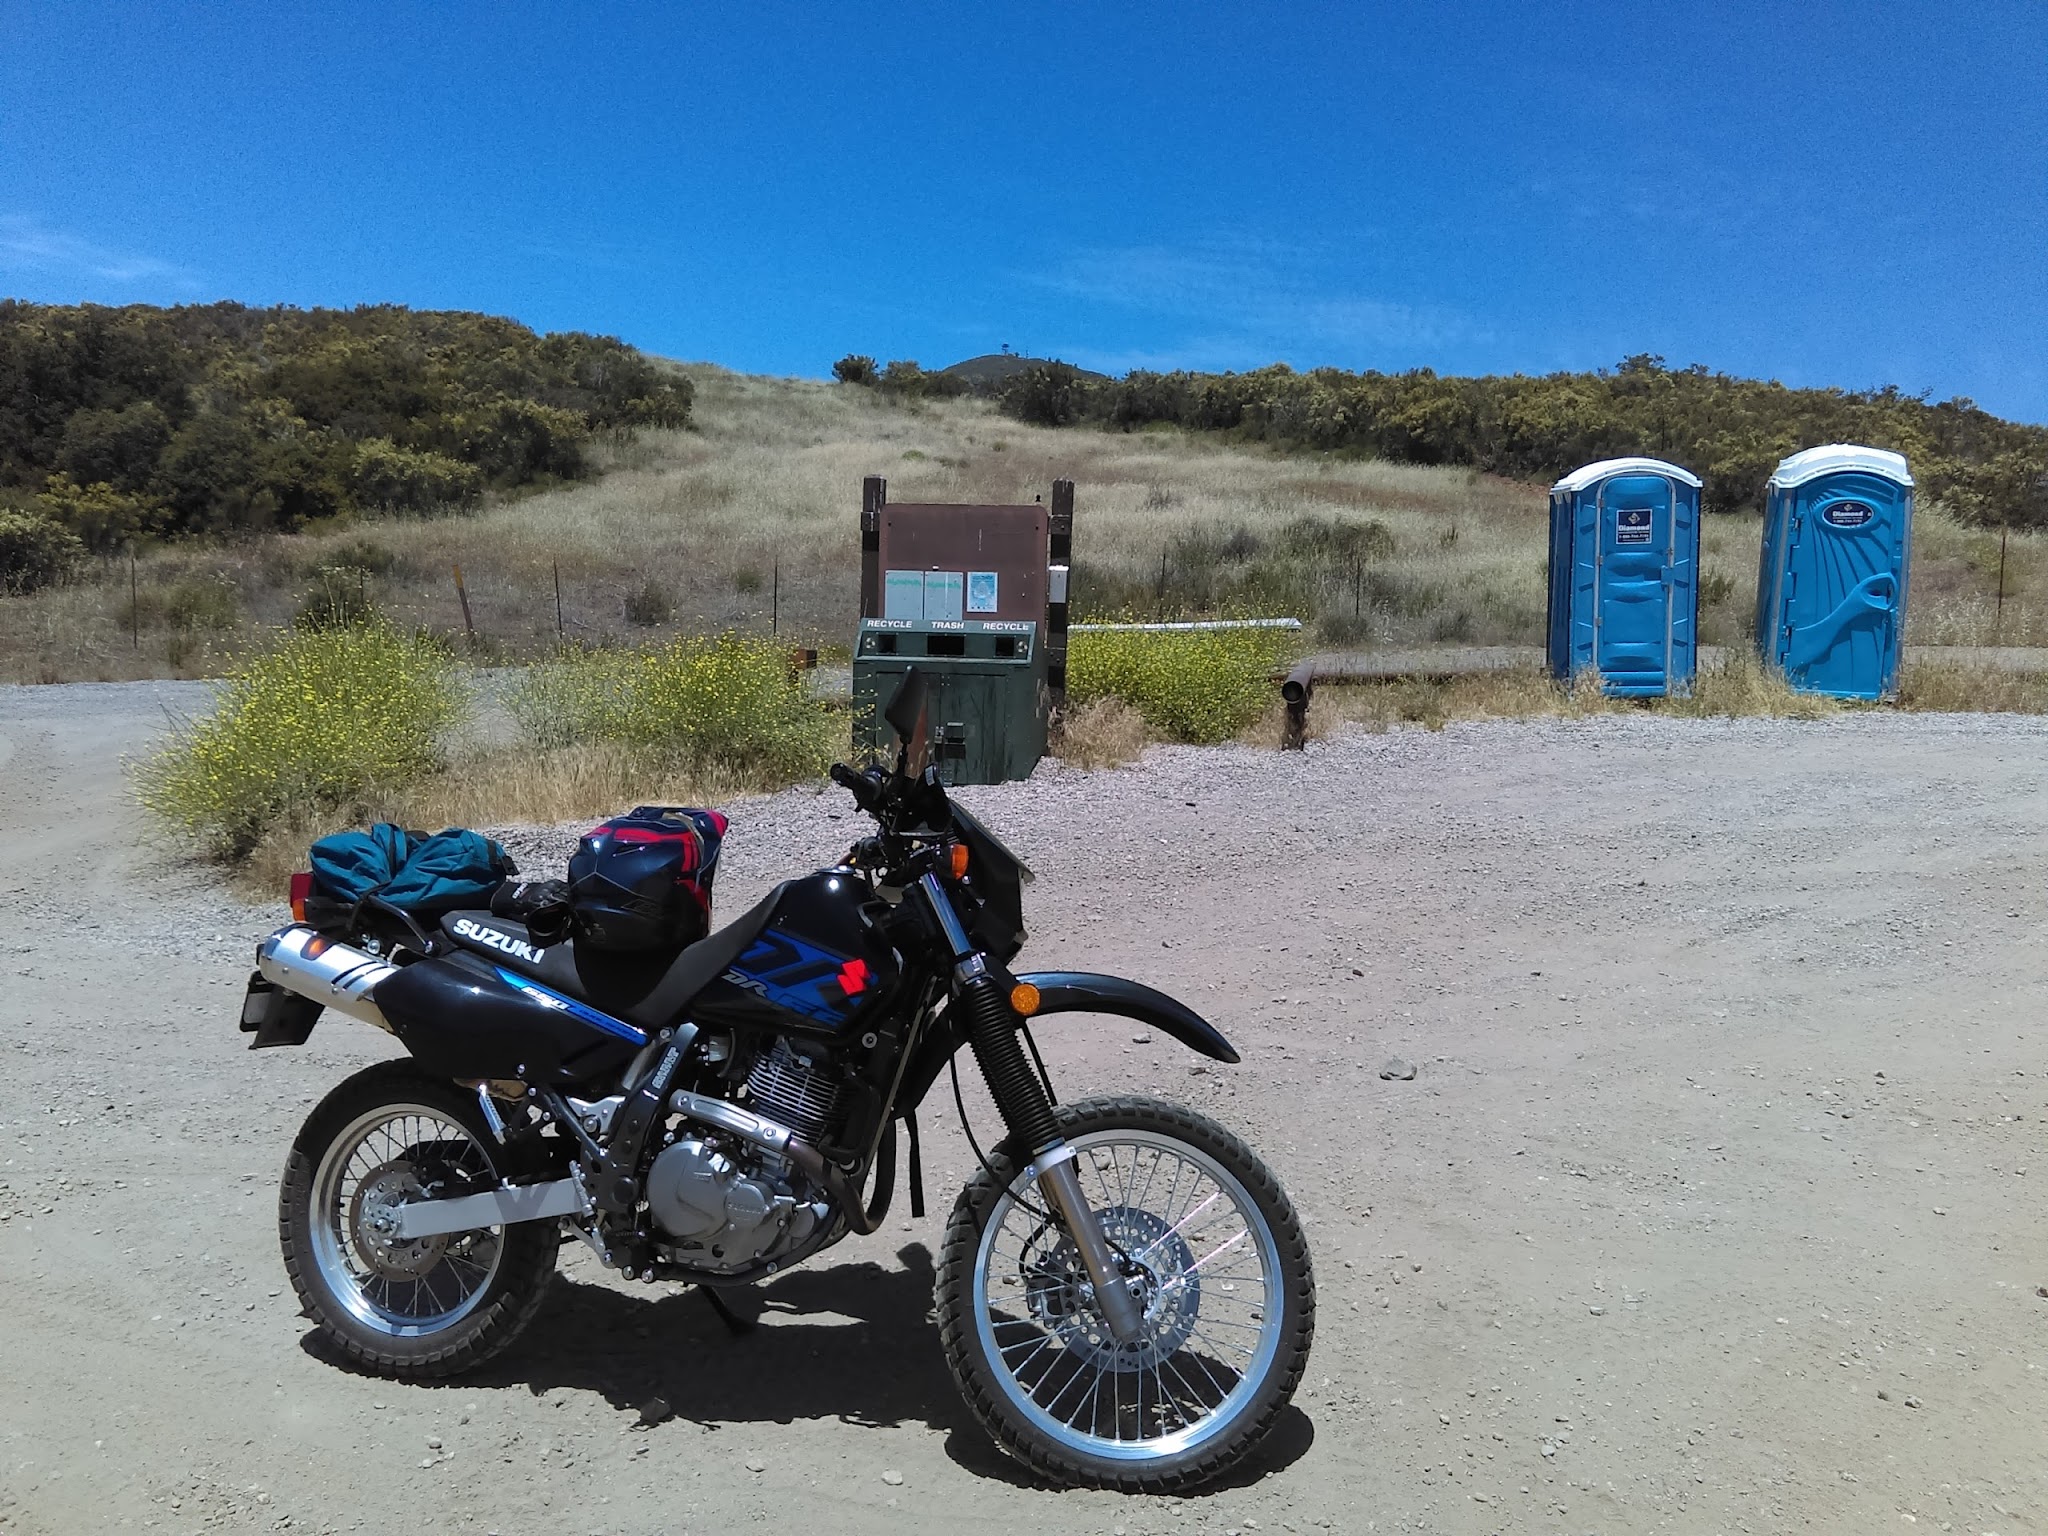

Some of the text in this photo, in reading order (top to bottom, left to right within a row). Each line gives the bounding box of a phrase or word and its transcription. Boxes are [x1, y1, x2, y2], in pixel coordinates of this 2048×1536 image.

[866, 619, 1029, 631] RECYCLE TRASH RECYCLE
[453, 918, 545, 964] SUZUKI
[720, 968, 769, 998] DR
